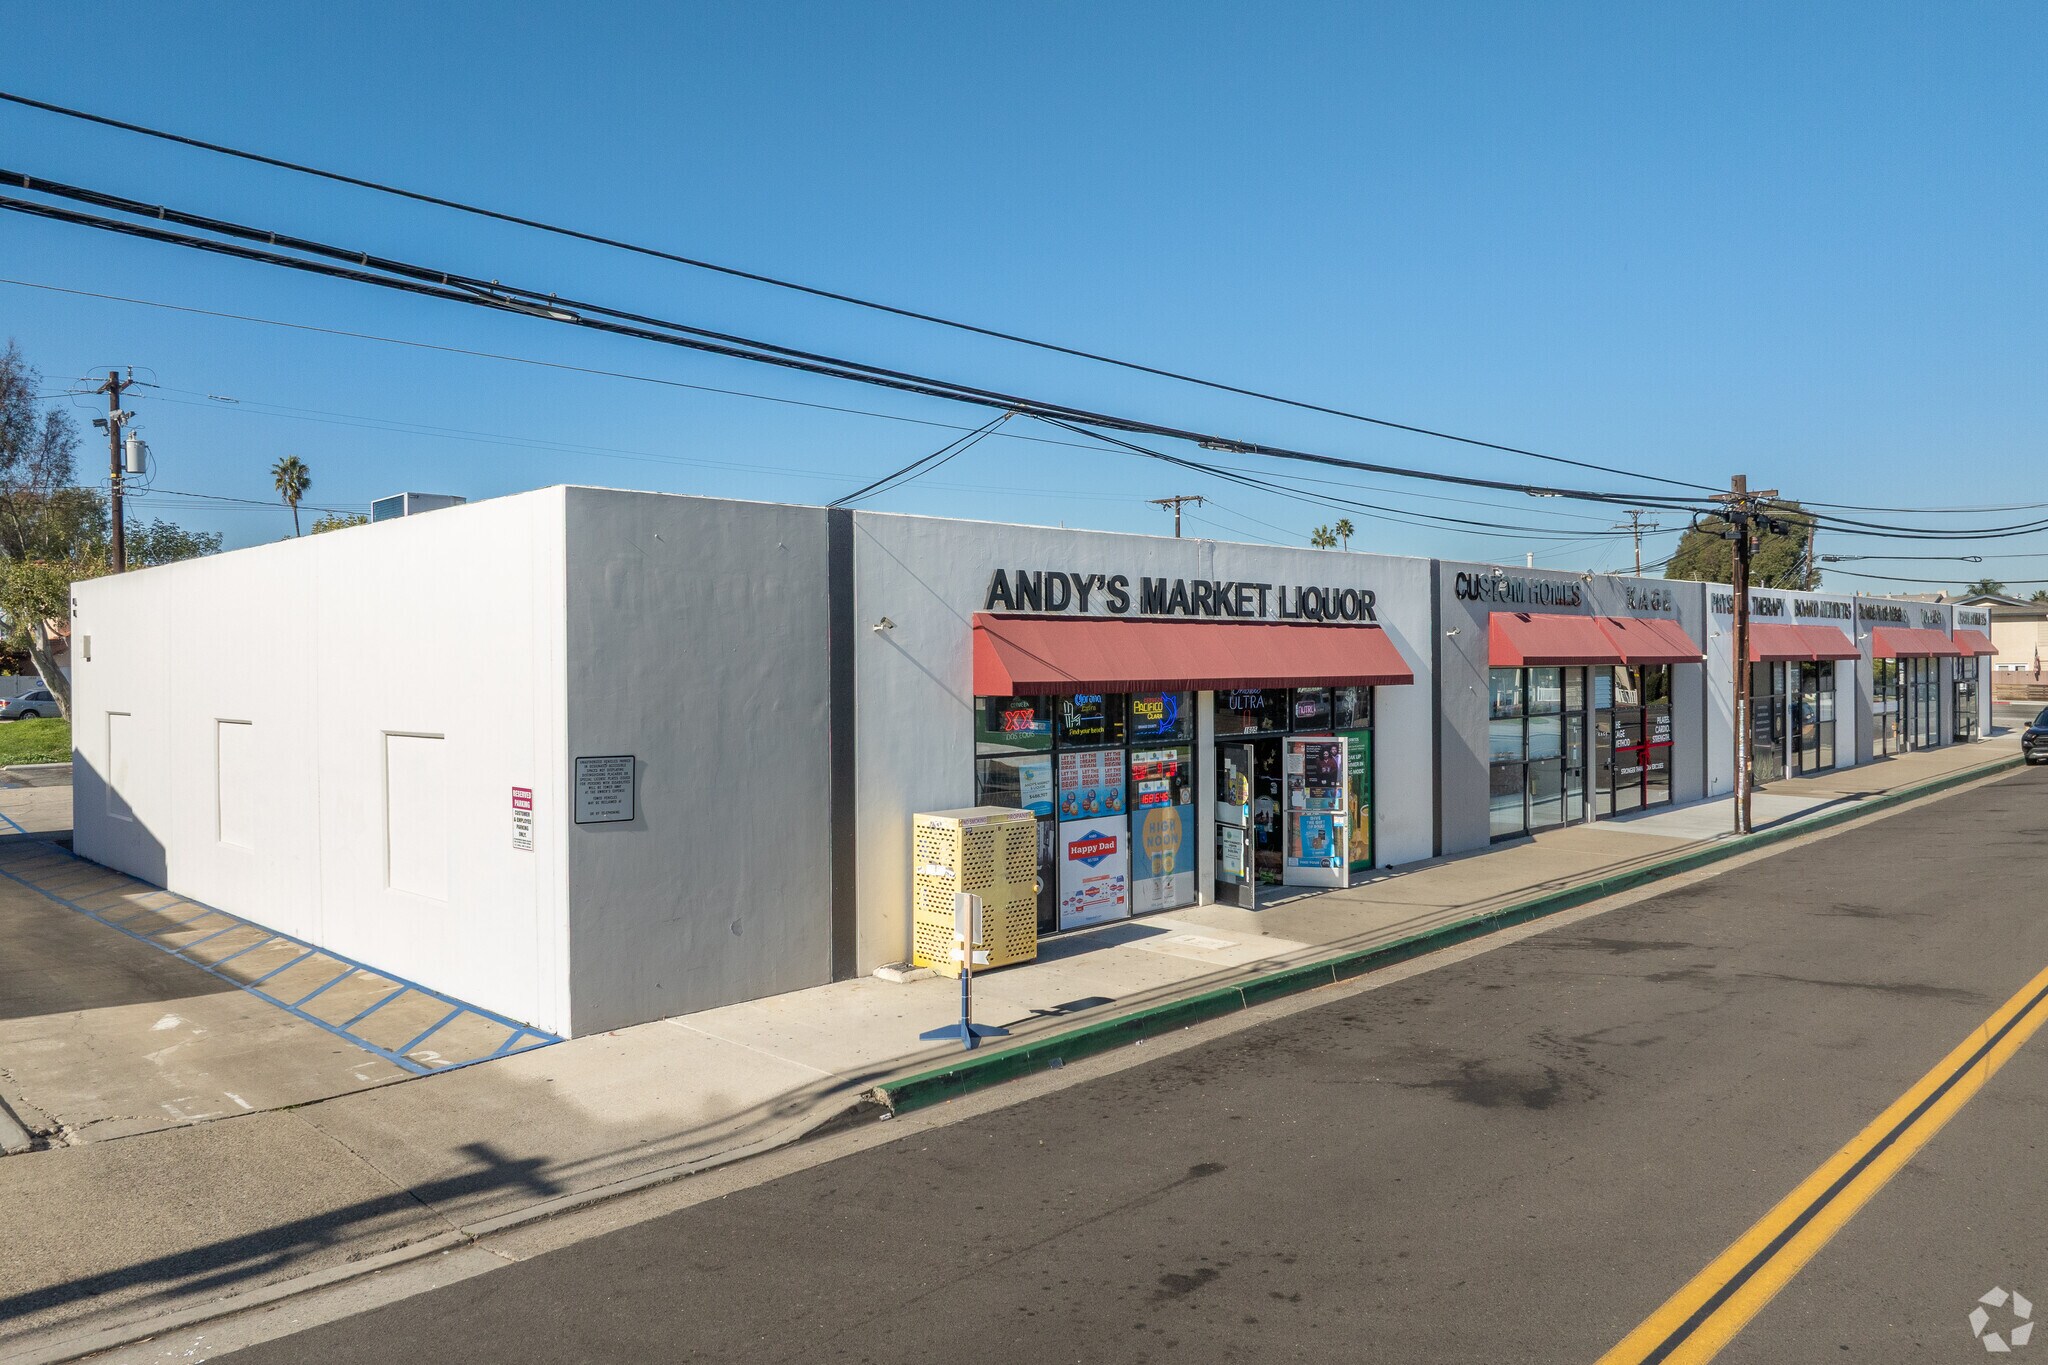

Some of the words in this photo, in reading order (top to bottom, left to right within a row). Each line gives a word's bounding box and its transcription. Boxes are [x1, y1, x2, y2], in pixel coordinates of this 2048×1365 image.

[986, 569, 1131, 614] ANDY'S
[1140, 576, 1272, 617] MARKET
[1279, 585, 1378, 622] LIQUOR
[1455, 571, 1524, 603] CUSTOM
[1529, 579, 1581, 607] HOMES
[1626, 586, 1672, 612] KAGE
[1752, 596, 1785, 617] THERAPY
[1074, 693, 1102, 706] Corona
[1229, 695, 1265, 710] ULTRA
[1005, 709, 1035, 731] XX
[1655, 725, 1670, 733] CARDIO.
[1149, 819, 1176, 834] HIGH
[1071, 844, 1098, 855] Happy
[1099, 841, 1115, 850] Dad
[1147, 834, 1179, 847] NOON
